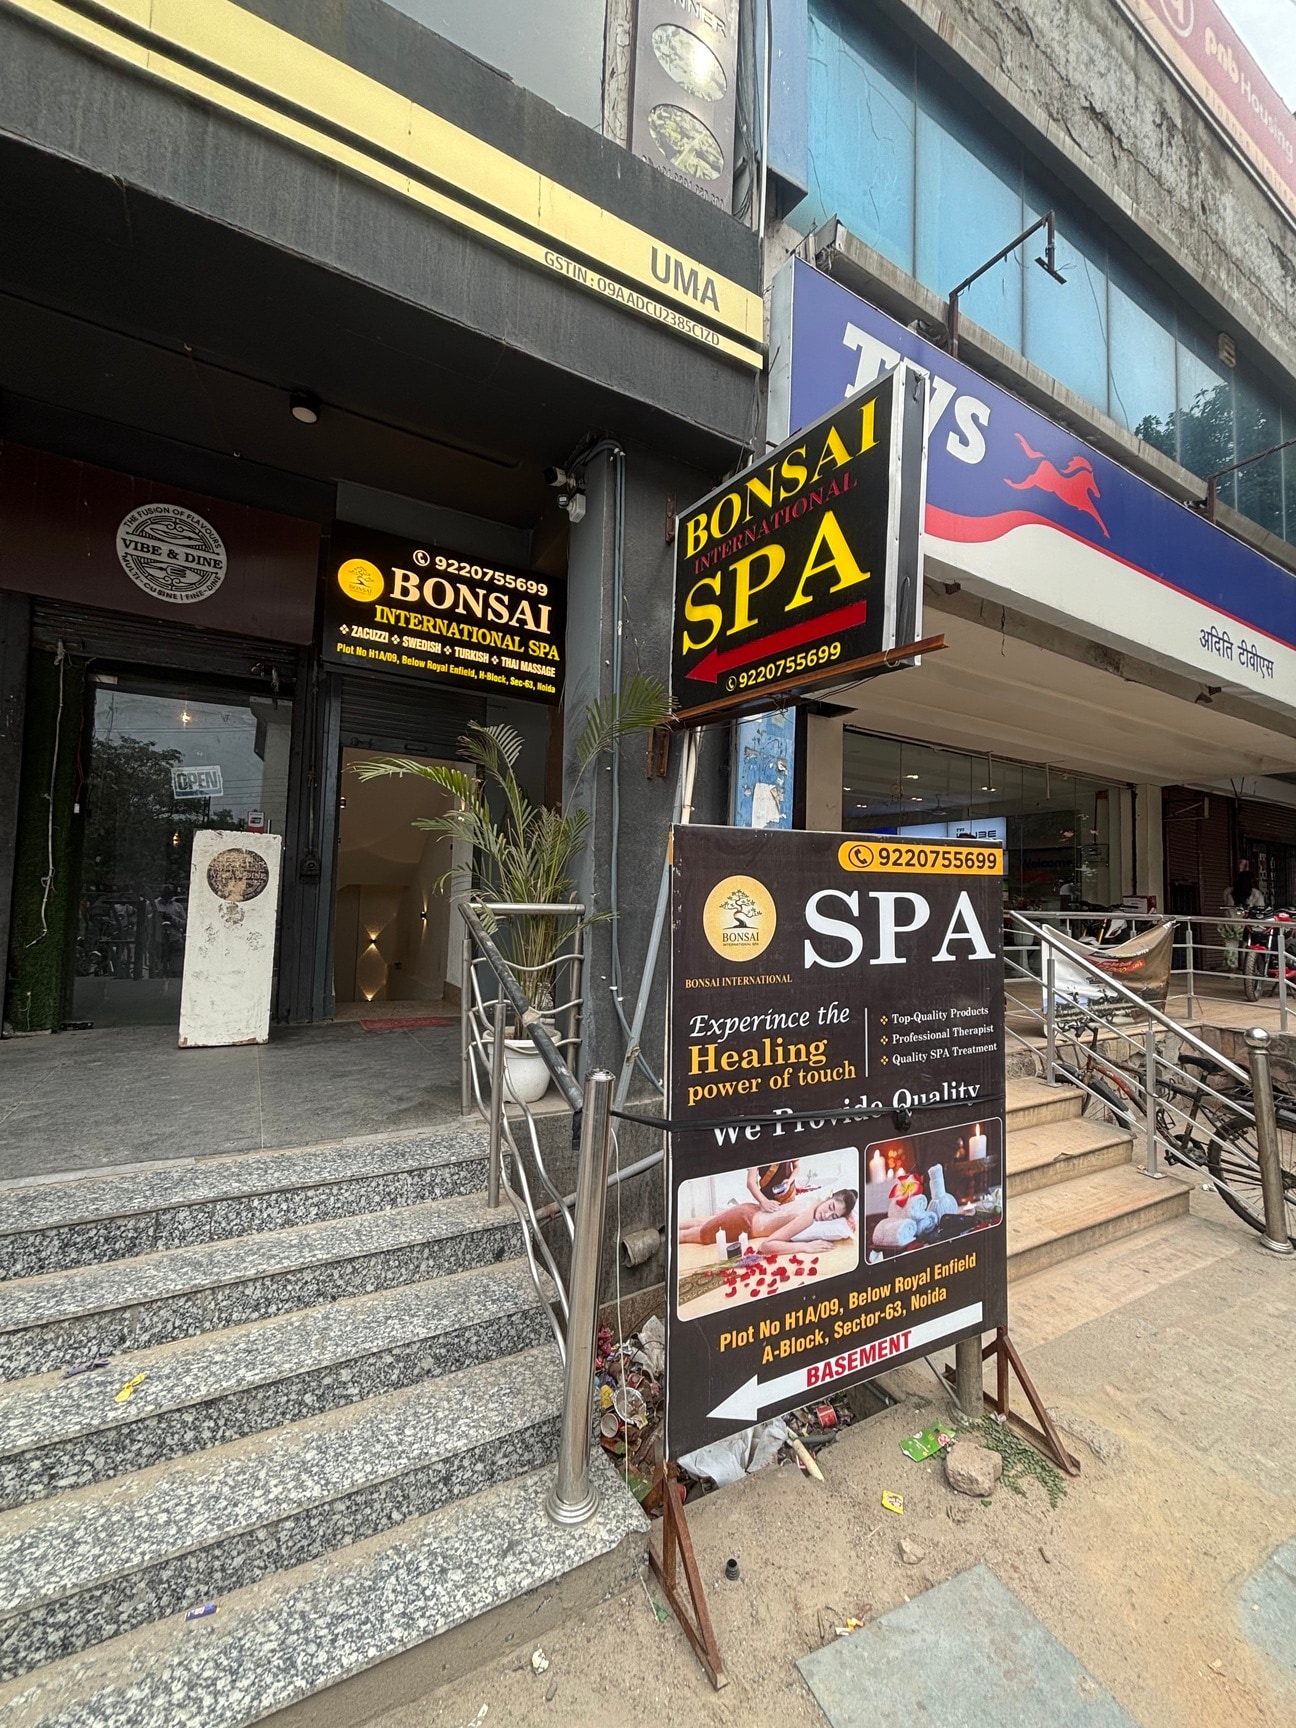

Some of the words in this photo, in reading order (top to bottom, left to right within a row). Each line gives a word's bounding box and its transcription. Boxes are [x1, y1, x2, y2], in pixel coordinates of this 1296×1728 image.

[1205, 27, 1240, 84] pnb
[544, 250, 588, 284] GSTIN
[651, 245, 720, 313] UMA
[684, 396, 880, 560] BONSAI
[123, 516, 139, 528] THE
[137, 507, 170, 518] FUSION
[172, 508, 185, 517] OF
[186, 514, 222, 549] FLAVOURS
[693, 471, 858, 574] INTERNATIONAL
[121, 537, 162, 556] VIBE
[167, 549, 179, 560] &
[184, 552, 223, 570] DINE
[434, 556, 548, 597] 9220755699
[389, 567, 552, 635] BONSAI
[682, 510, 871, 656] SPA
[351, 625, 389, 643] ZACUZZI
[402, 635, 442, 654] SWEDISH
[454, 646, 489, 664] TURKISH
[501, 656, 519, 670] THAI
[520, 661, 556, 678] MASSAGE
[374, 604, 525, 653] INTERNATIONAL
[528, 640, 560, 661] SPA
[1199, 625, 1234, 661] अदिति
[1237, 639, 1274, 679] टीवीएस
[337, 642, 355, 654] Plot
[355, 646, 367, 657] No
[368, 648, 400, 664] H1A/09,
[401, 655, 425, 668] Below
[427, 660, 448, 672] Royal
[449, 664, 478, 679] Enfield,
[479, 671, 509, 685] H-Block,
[510, 676, 536, 691] Sec-63,
[537, 682, 556, 693] Noida
[738, 641, 841, 689] 9220755699
[176, 771, 218, 790] OPEN
[878, 847, 997, 870] 9220755699
[722, 932, 759, 942] BONSAI
[804, 889, 996, 969] SPA
[685, 978, 720, 989] BONSAI
[721, 974, 793, 987] INTERNATIONAL
[689, 1008, 810, 1043] Experince
[817, 1001, 850, 1025] the
[891, 1010, 948, 1024] Top-Quality
[950, 1006, 989, 1018] Products
[892, 1028, 950, 1044] Professional
[952, 1024, 994, 1037] Therapist
[687, 1036, 828, 1076] Healing
[892, 1051, 928, 1066] Quality
[930, 1048, 950, 1059] SPA
[952, 1042, 998, 1056] Treatment
[687, 1076, 762, 1106] power
[769, 1067, 793, 1090] of
[798, 1059, 857, 1086] touch
[719, 1327, 754, 1352] Plot
[759, 1319, 780, 1339] No
[785, 1298, 844, 1331] H1A/09,
[848, 1283, 891, 1310] Below
[894, 1266, 931, 1295] Royal
[934, 1252, 977, 1280] Enfield
[762, 1327, 830, 1365] A-Block,
[833, 1300, 907, 1339] Sector-63,
[911, 1287, 948, 1312] Noida
[806, 1330, 912, 1388] BASEMENT
